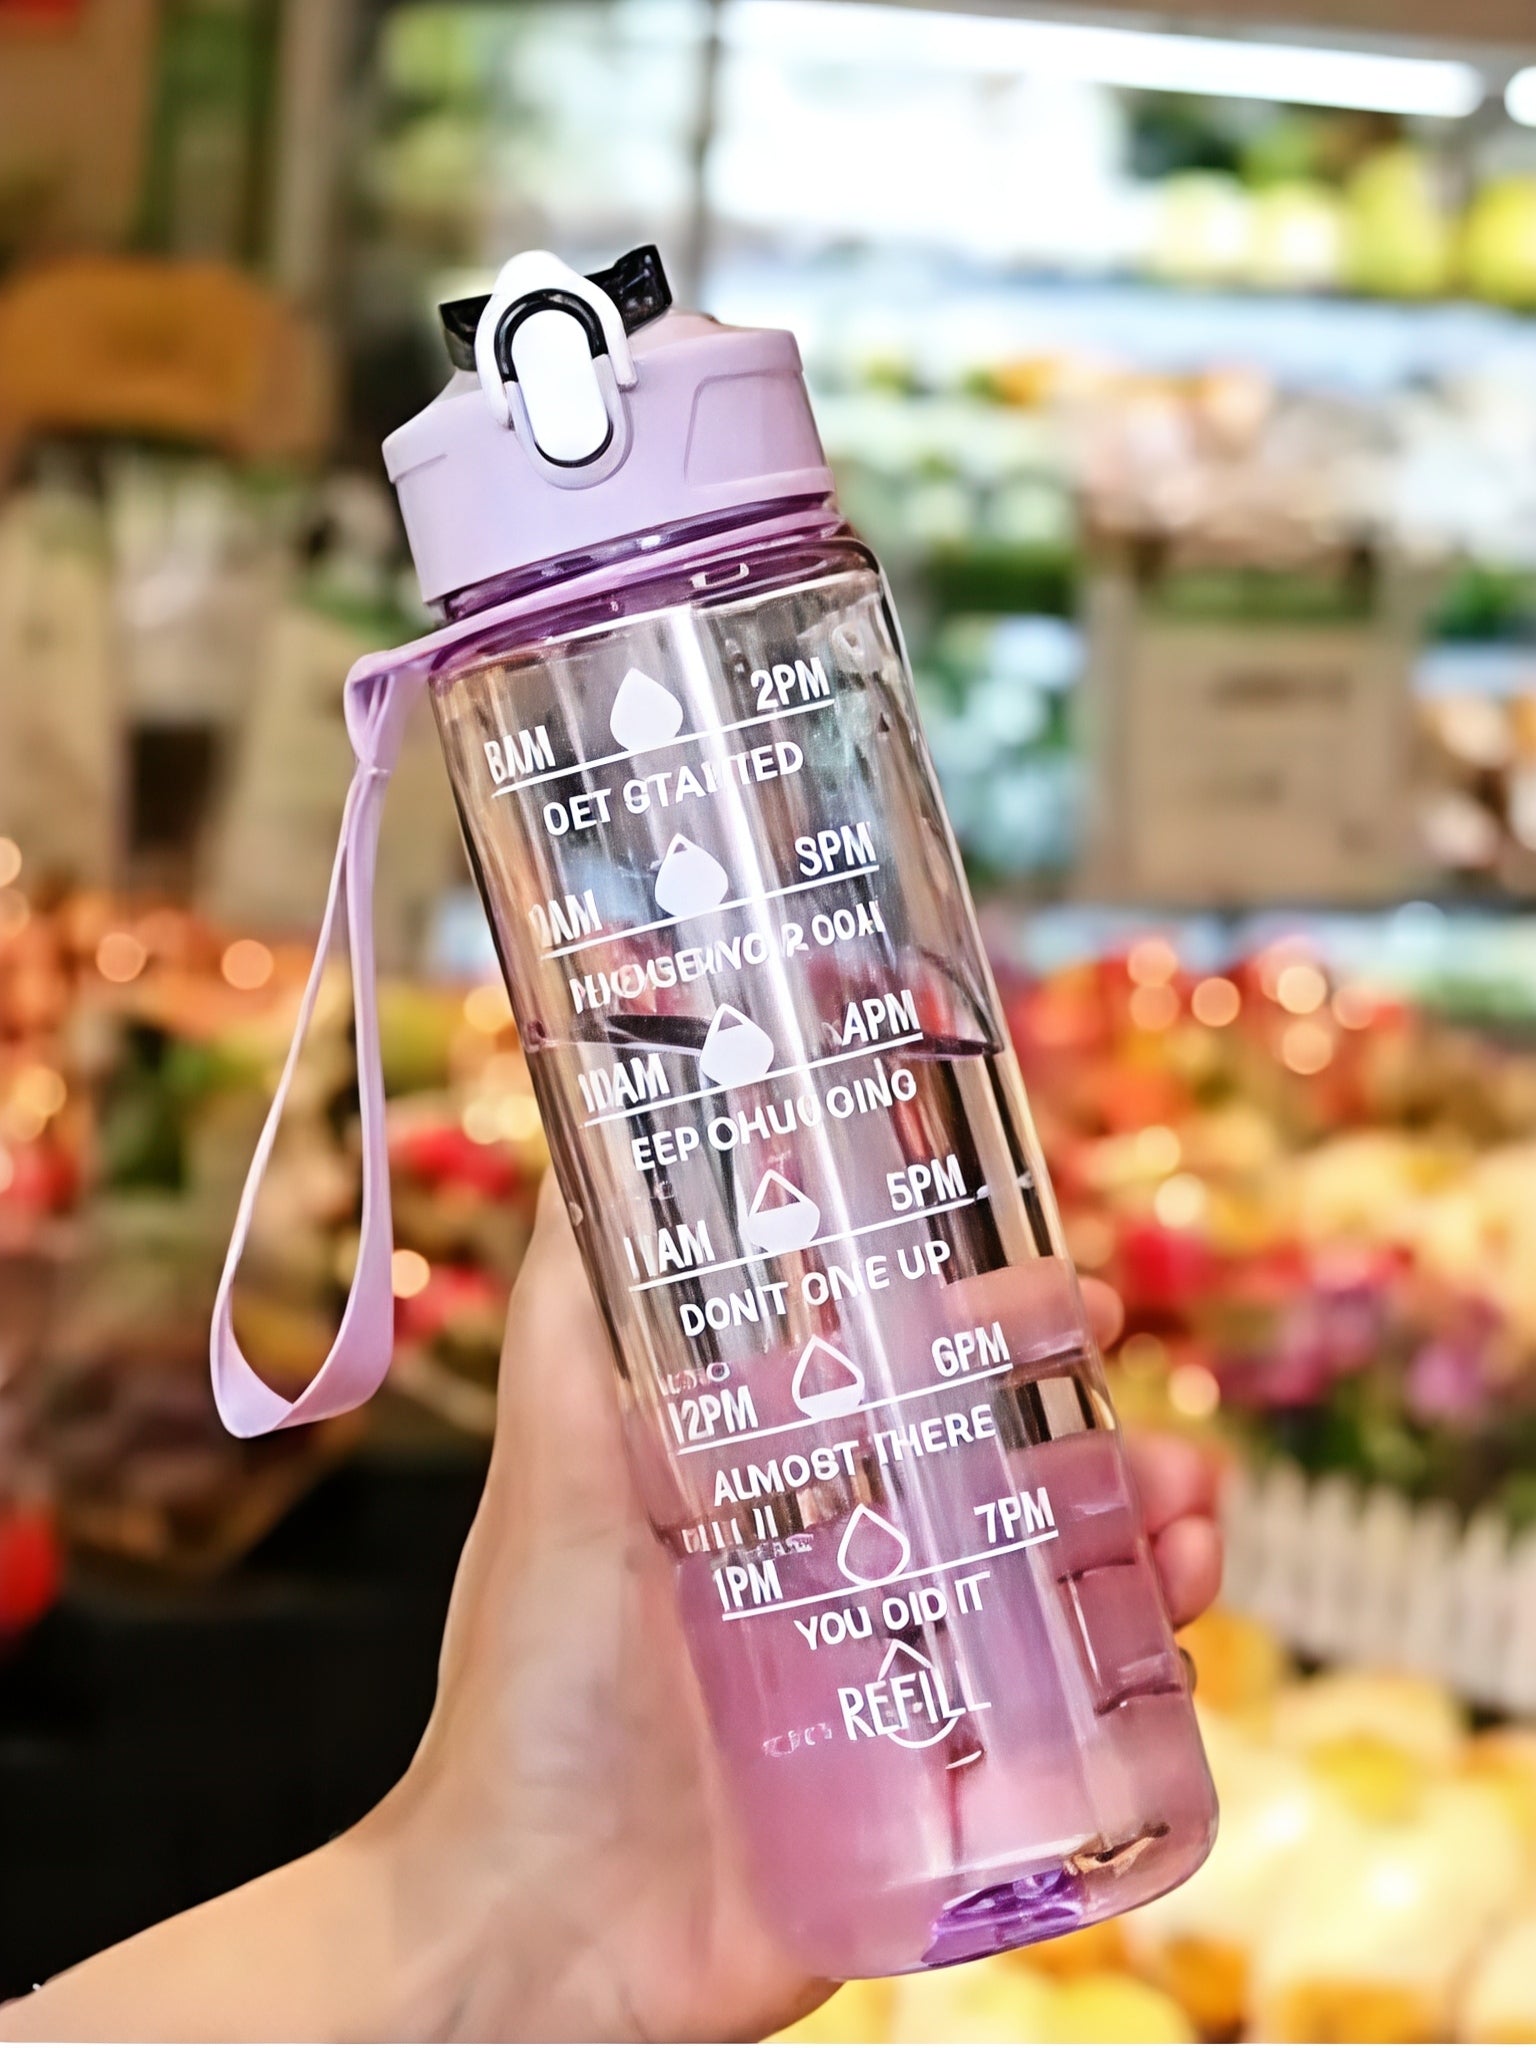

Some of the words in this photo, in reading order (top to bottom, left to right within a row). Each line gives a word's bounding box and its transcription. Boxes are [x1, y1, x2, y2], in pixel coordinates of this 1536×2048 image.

[750, 657, 831, 711] 2PM
[886, 1154, 968, 1211] 5PM
[898, 1239, 951, 1280] UP
[667, 1386, 759, 1445] 12PM
[714, 1440, 859, 1506] ALMOST
[712, 1560, 783, 1612] 1PM
[973, 1486, 1055, 1544] 7PM
[794, 1605, 872, 1651] YOU
[955, 1571, 990, 1614] IT
[837, 1660, 991, 1741] REFILL
